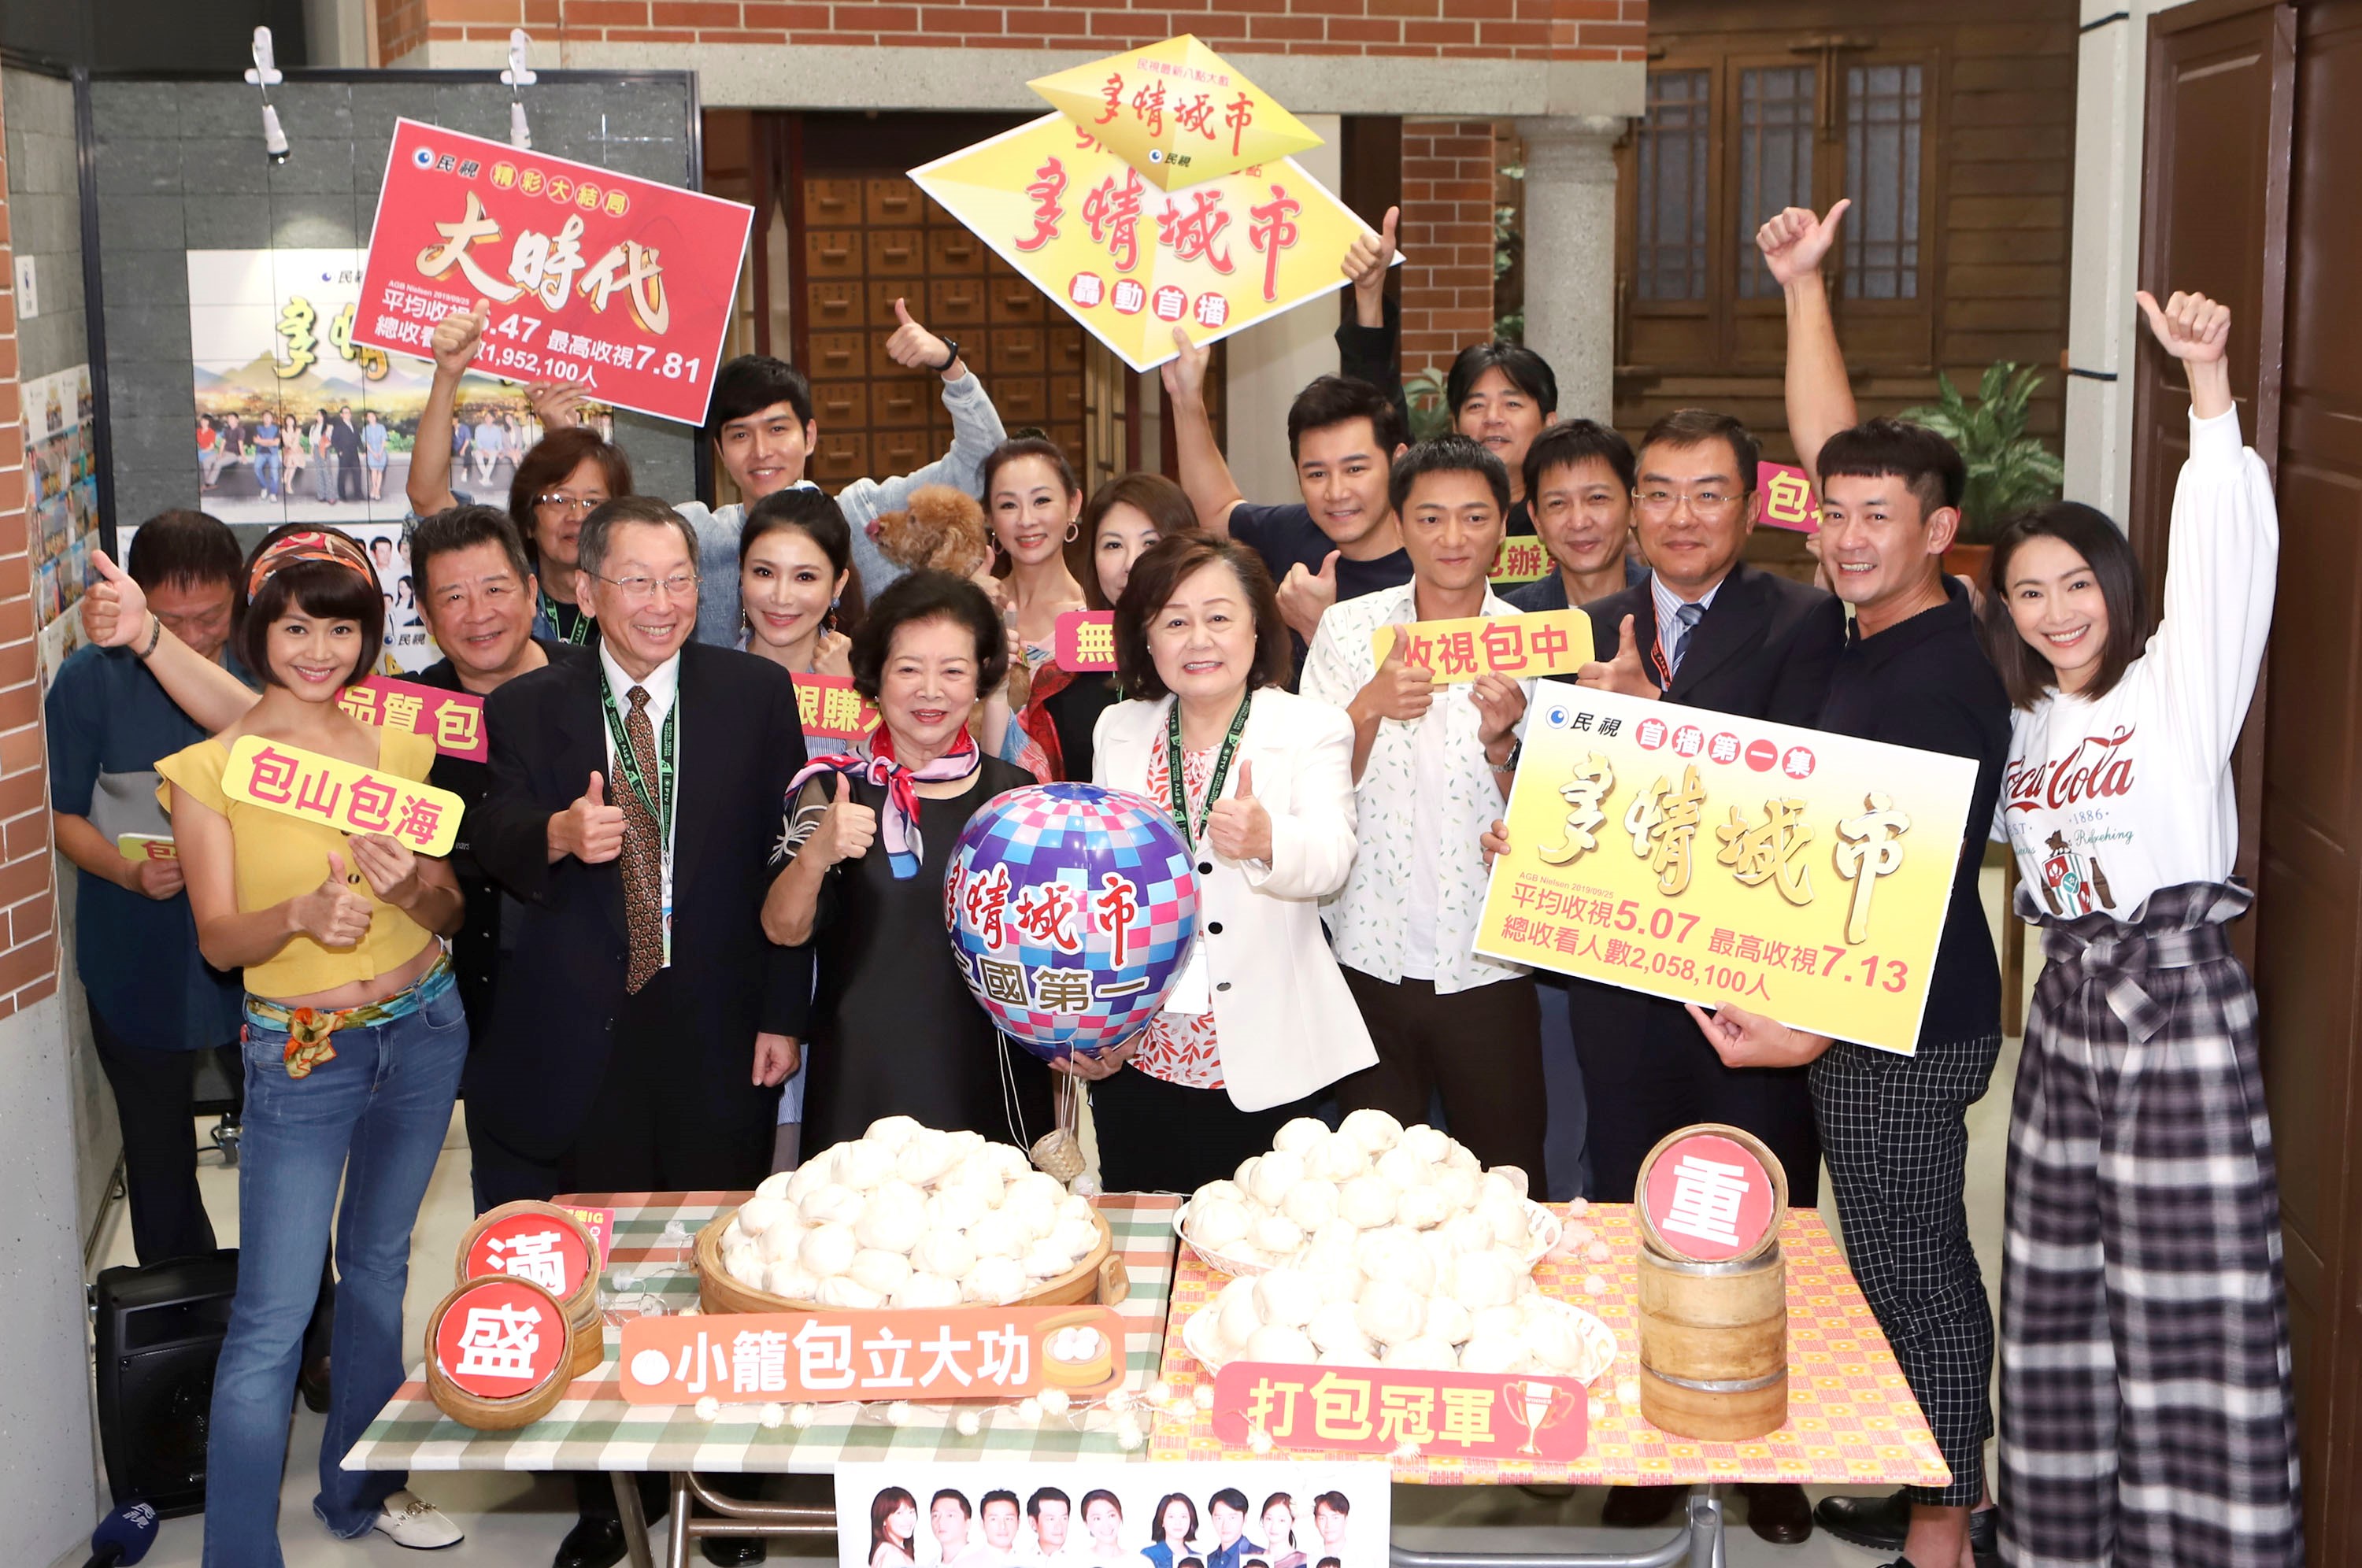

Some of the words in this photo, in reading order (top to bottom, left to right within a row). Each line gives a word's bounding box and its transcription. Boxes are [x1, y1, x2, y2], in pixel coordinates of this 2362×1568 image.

[1094, 72, 1254, 157] 多情城市
[435, 154, 479, 178] 民視
[491, 162, 629, 216] 精彩大結局
[1164, 152, 1191, 168] 民視
[415, 190, 670, 336] 大時代
[1014, 157, 1303, 302] 多情城市
[382, 288, 542, 343] 平均收.47
[546, 328, 701, 383] 最高收視7.81
[1071, 273, 1227, 327] 轟動首播
[374, 315, 598, 388] 總收看1,952,100人
[398, 634, 426, 646] 民視
[1075, 620, 1115, 664] 無
[1405, 622, 1568, 677] 收視包中
[337, 685, 480, 750] 品質包
[1570, 711, 1623, 738] 民視
[1638, 719, 1812, 778] 首播第一集
[248, 745, 443, 845] 包山包海
[1220, 756, 1228, 771] FTV
[1538, 749, 1912, 945] 多情城市
[1519, 871, 1538, 882] AGB
[1540, 876, 1570, 889] Nielsen
[1572, 882, 1614, 899] 2019/09/25
[1501, 914, 1771, 1001] 總收看人數2,058,100人
[1511, 882, 1701, 944] 平均收視5.07
[1707, 927, 1908, 994] 最高收視7.13
[1661, 1154, 1750, 1248] 重
[485, 1230, 566, 1298] 滿
[456, 1303, 543, 1380] 盛
[674, 1318, 1030, 1394] 小籠包立大功
[1247, 1371, 1496, 1448] 打包冠軍
